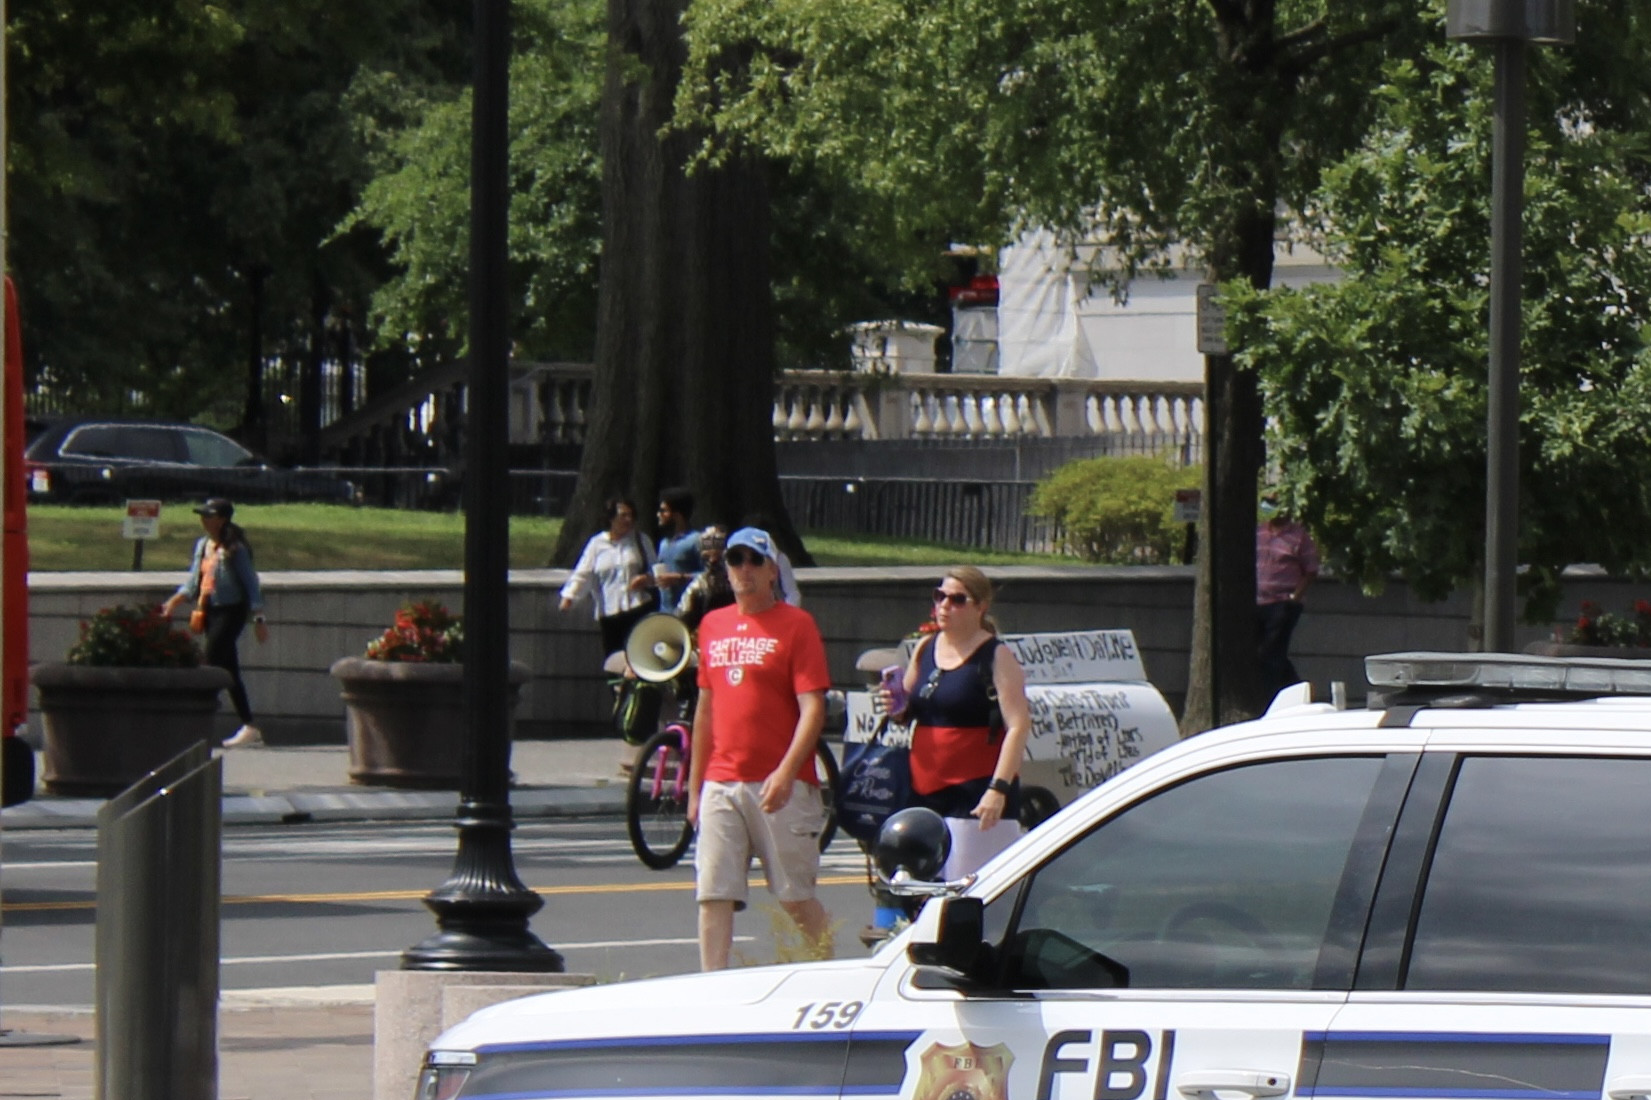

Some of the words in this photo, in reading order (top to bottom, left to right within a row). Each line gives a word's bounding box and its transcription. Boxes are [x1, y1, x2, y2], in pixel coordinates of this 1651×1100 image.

[708, 637, 778, 655] CARTHAGE
[710, 649, 766, 667] COLLEGE
[792, 1000, 864, 1030] 159
